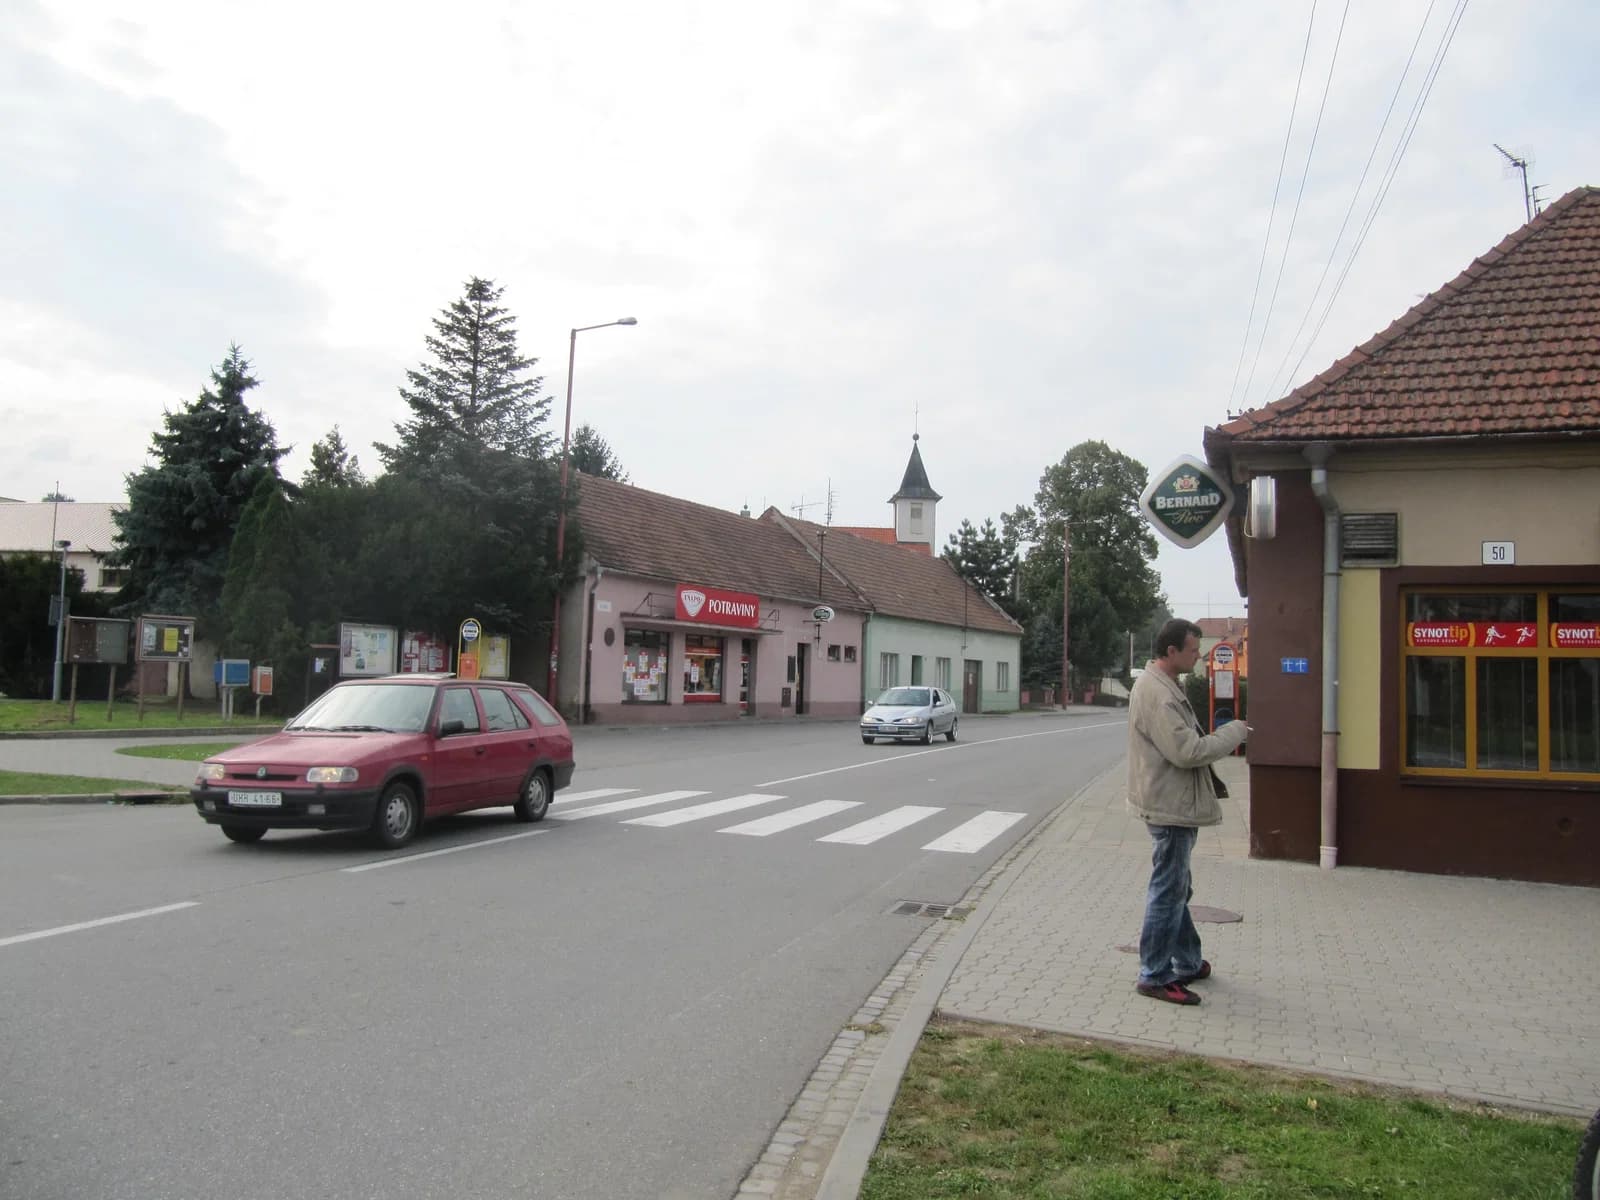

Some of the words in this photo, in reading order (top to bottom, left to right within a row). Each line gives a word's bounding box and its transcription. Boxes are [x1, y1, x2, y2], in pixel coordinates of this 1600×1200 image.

[1155, 493, 1221, 510] BERNARD
[1492, 546, 1505, 561] 50
[708, 599, 756, 618] POTRAVINY
